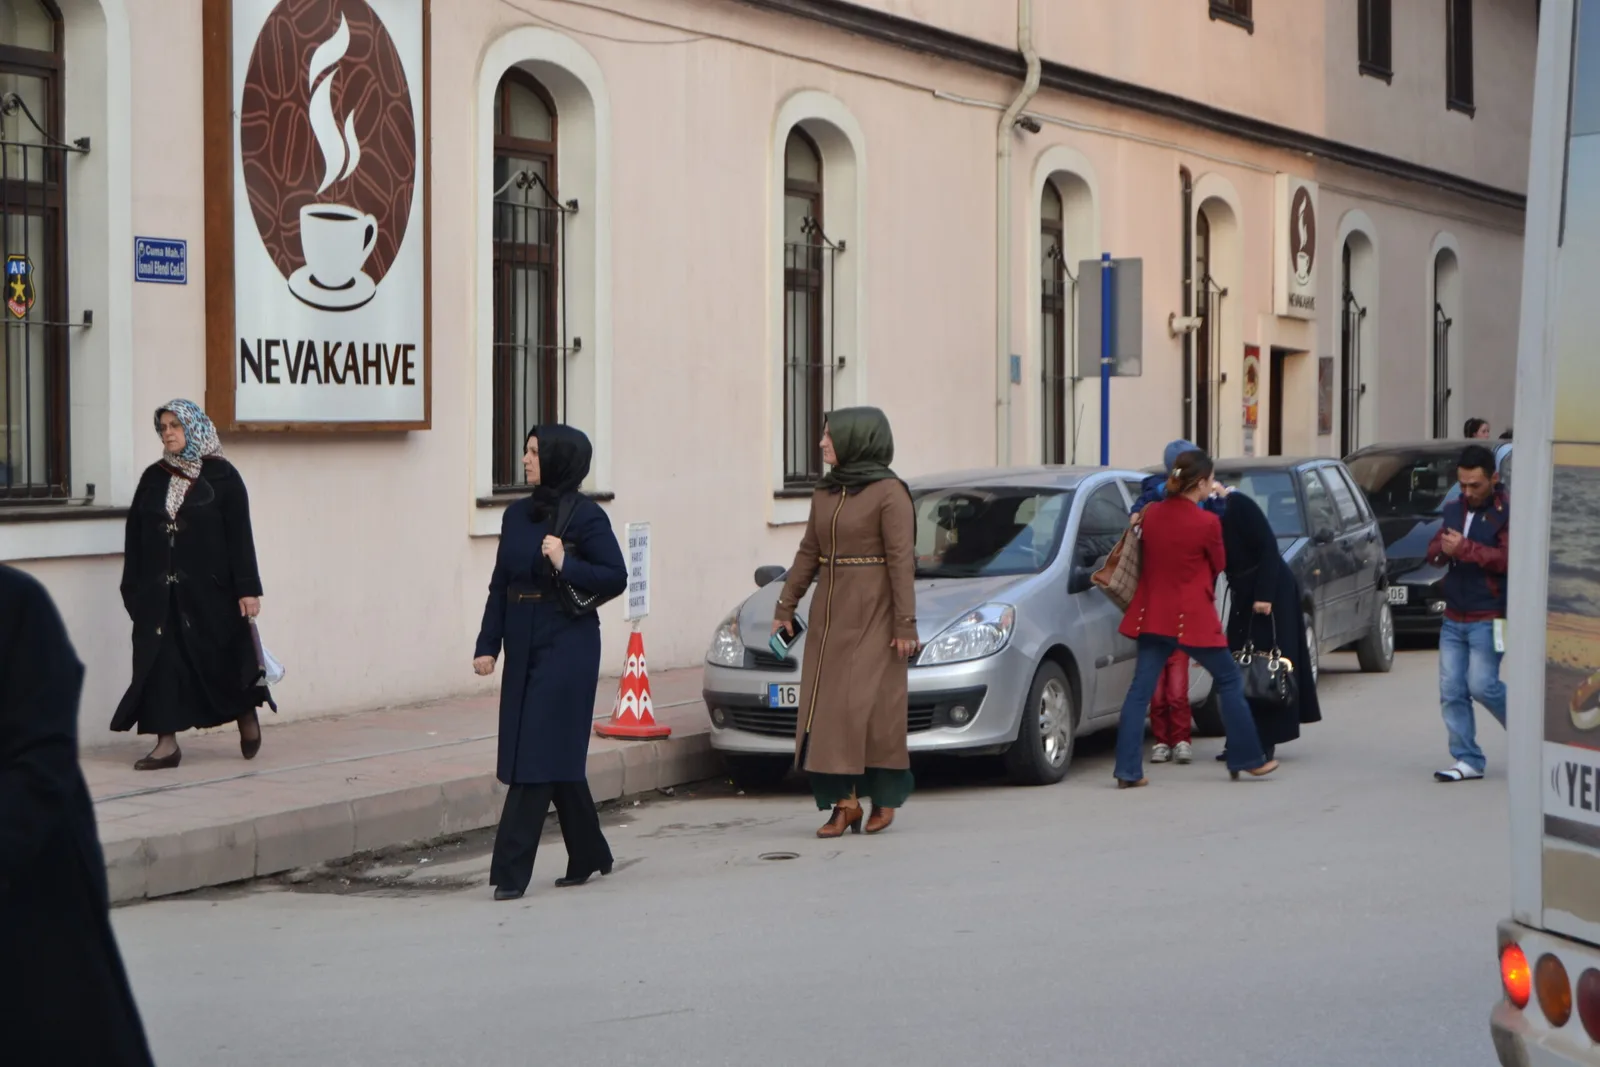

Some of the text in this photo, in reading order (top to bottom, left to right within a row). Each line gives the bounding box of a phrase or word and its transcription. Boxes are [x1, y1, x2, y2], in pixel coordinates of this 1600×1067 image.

[146, 245, 164, 257] Cuma
[240, 337, 416, 386] NEVAKAHVE
[779, 686, 797, 704] 16
